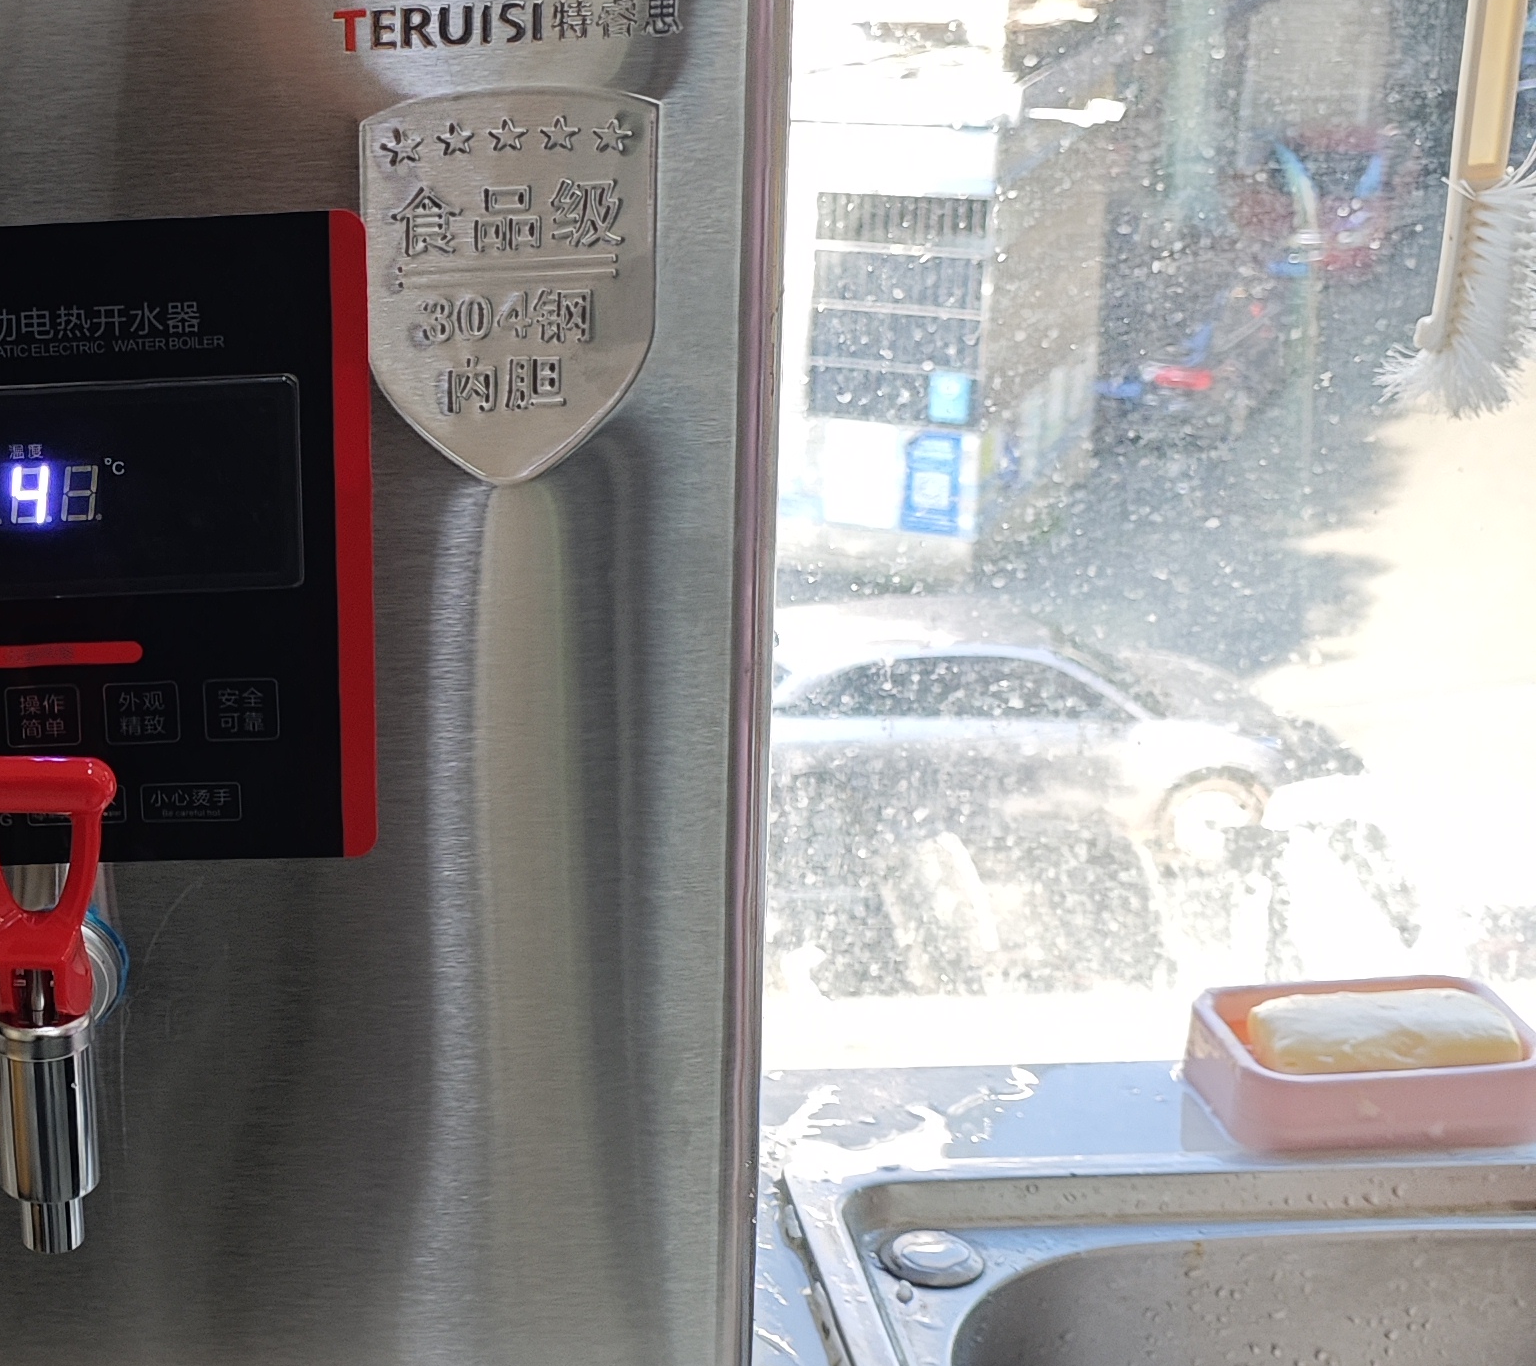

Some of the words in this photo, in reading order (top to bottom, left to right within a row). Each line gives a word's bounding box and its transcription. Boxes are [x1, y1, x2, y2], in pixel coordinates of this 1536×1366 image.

[333, 0, 544, 52] TERUISI
[391, 178, 625, 257] 食品级
[419, 288, 592, 344] 304钢
[31, 339, 106, 356] ELECTRIC
[111, 337, 168, 353] WATER
[169, 333, 225, 350] BOILER
[445, 356, 567, 414] 内胆
[8, 443, 44, 460] 温度
[18, 693, 66, 716] 操作
[118, 691, 166, 713] 外观
[217, 687, 264, 709] 安全
[20, 717, 67, 739] 简单
[119, 714, 166, 736] 精致
[219, 711, 266, 733] 可靠
[150, 788, 232, 807] 小心烫手
